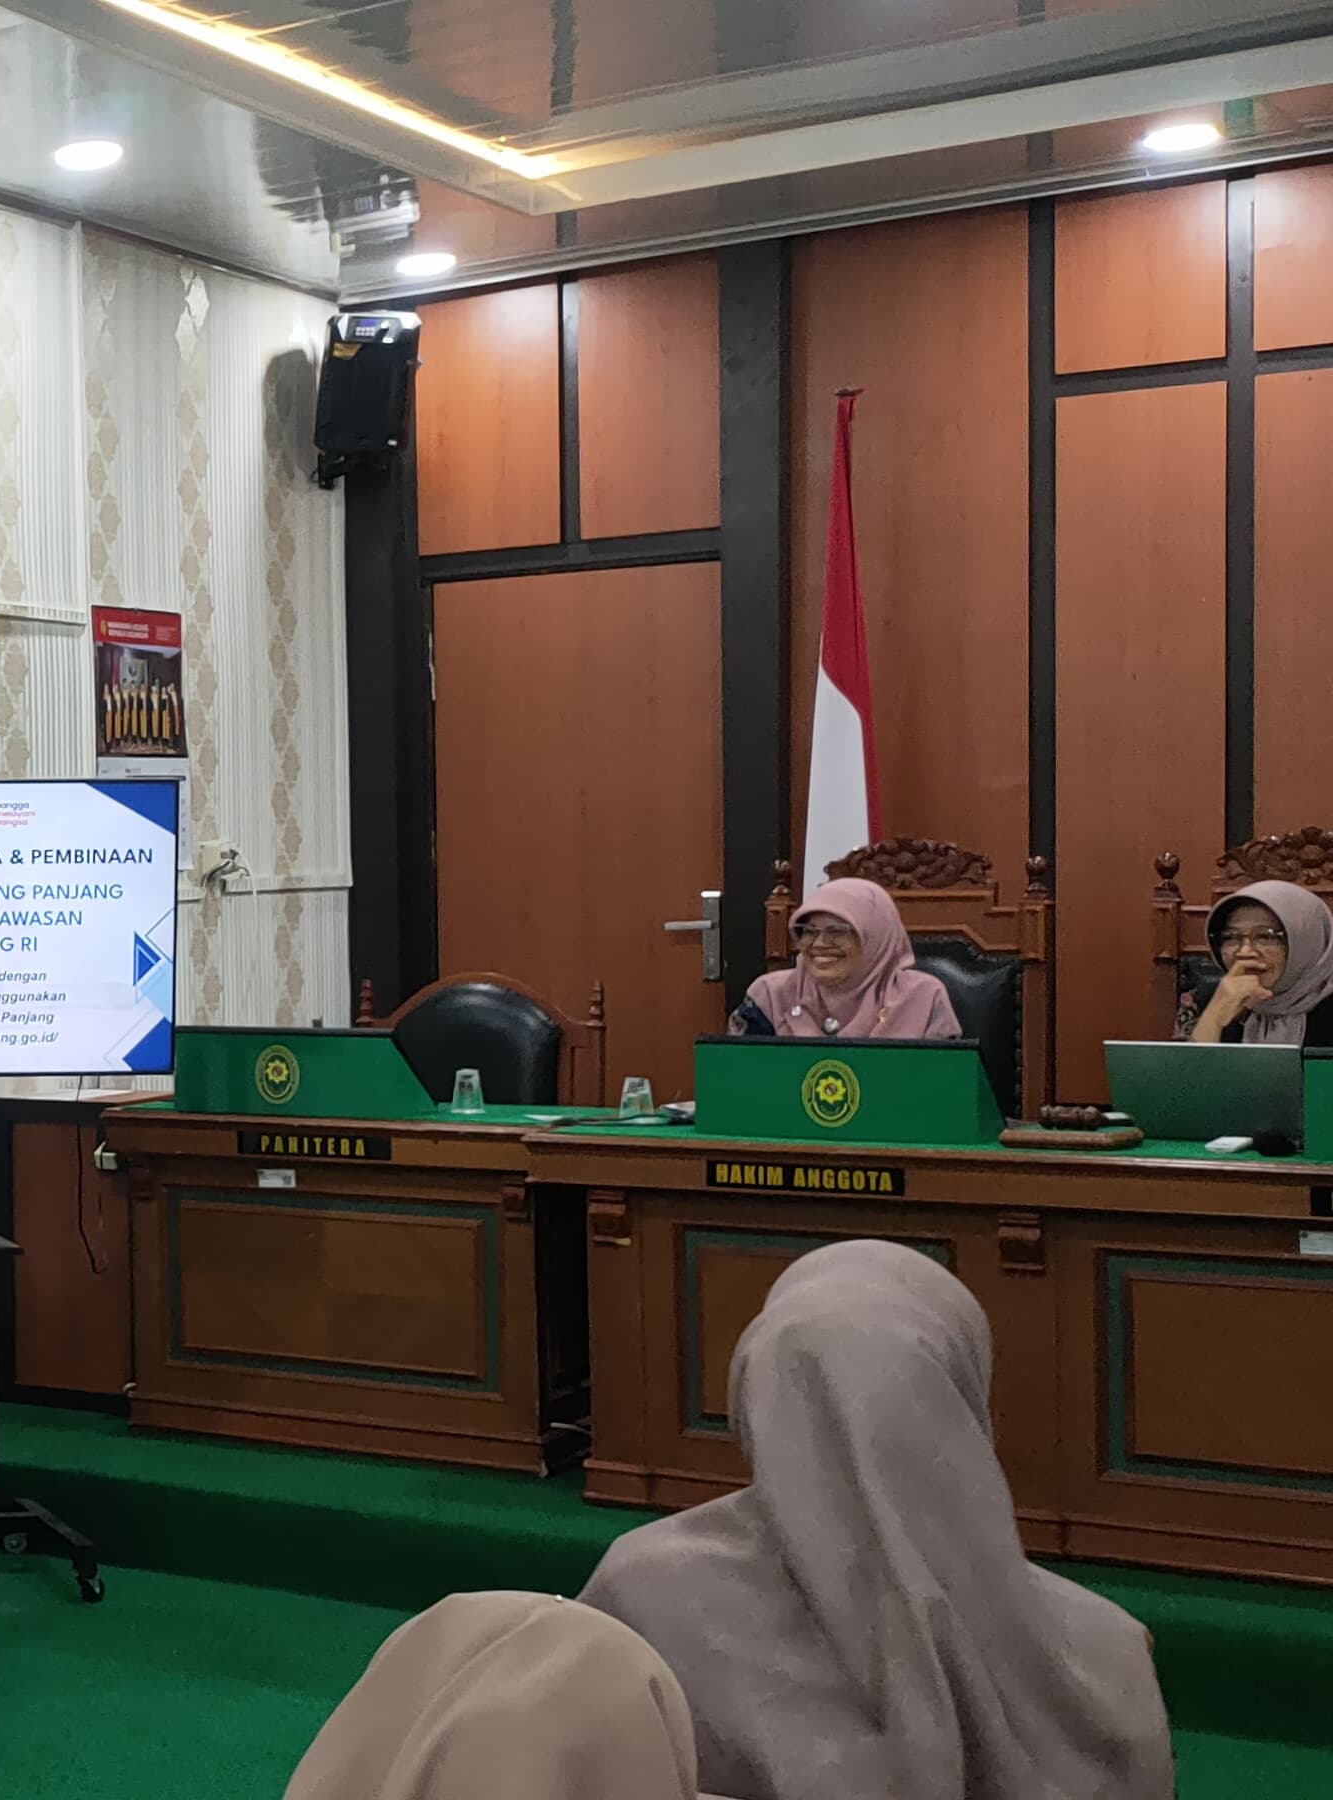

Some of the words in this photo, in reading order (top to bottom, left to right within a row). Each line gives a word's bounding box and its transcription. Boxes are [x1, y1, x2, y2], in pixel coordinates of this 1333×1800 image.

[10, 850, 23, 864] &
[32, 849, 153, 864] PEMBINAAN
[33, 884, 124, 900] PANJANG
[21, 937, 38, 951] RI
[1, 1011, 54, 1024] Panjang
[261, 1135, 365, 1156] PANITERA
[716, 1163, 783, 1186] HAKIM
[793, 1167, 893, 1192] ANGGOTA
